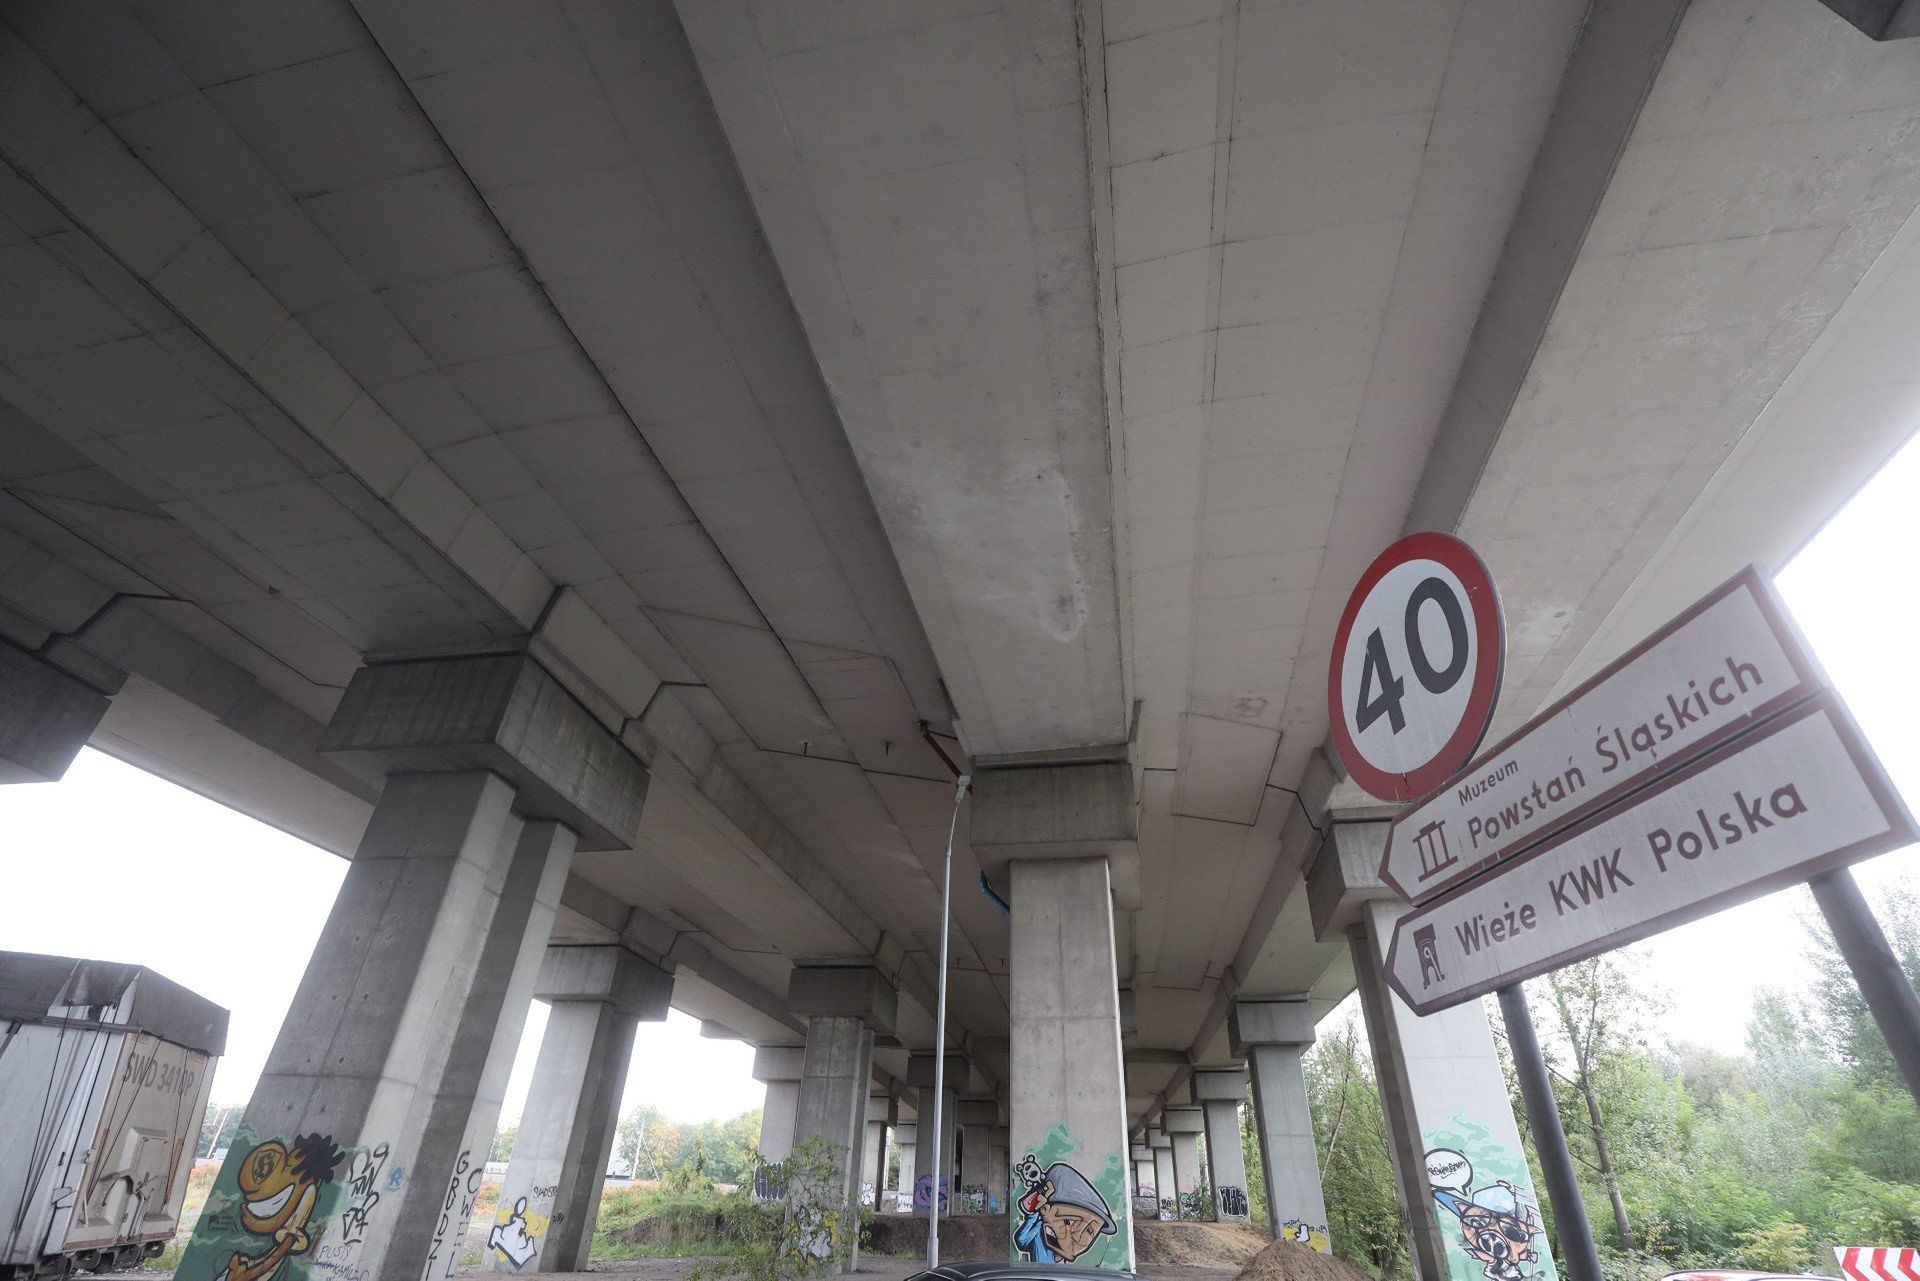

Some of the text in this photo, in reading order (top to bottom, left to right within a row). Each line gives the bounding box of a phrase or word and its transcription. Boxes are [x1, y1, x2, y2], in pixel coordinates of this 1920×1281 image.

[1356, 577, 1468, 735] 40
[1458, 760, 1519, 806] Muzeum
[1468, 656, 1763, 849] Powstań Śląskich
[1455, 782, 1808, 956] Wieże KWK Polska
[123, 1051, 159, 1087] SWD
